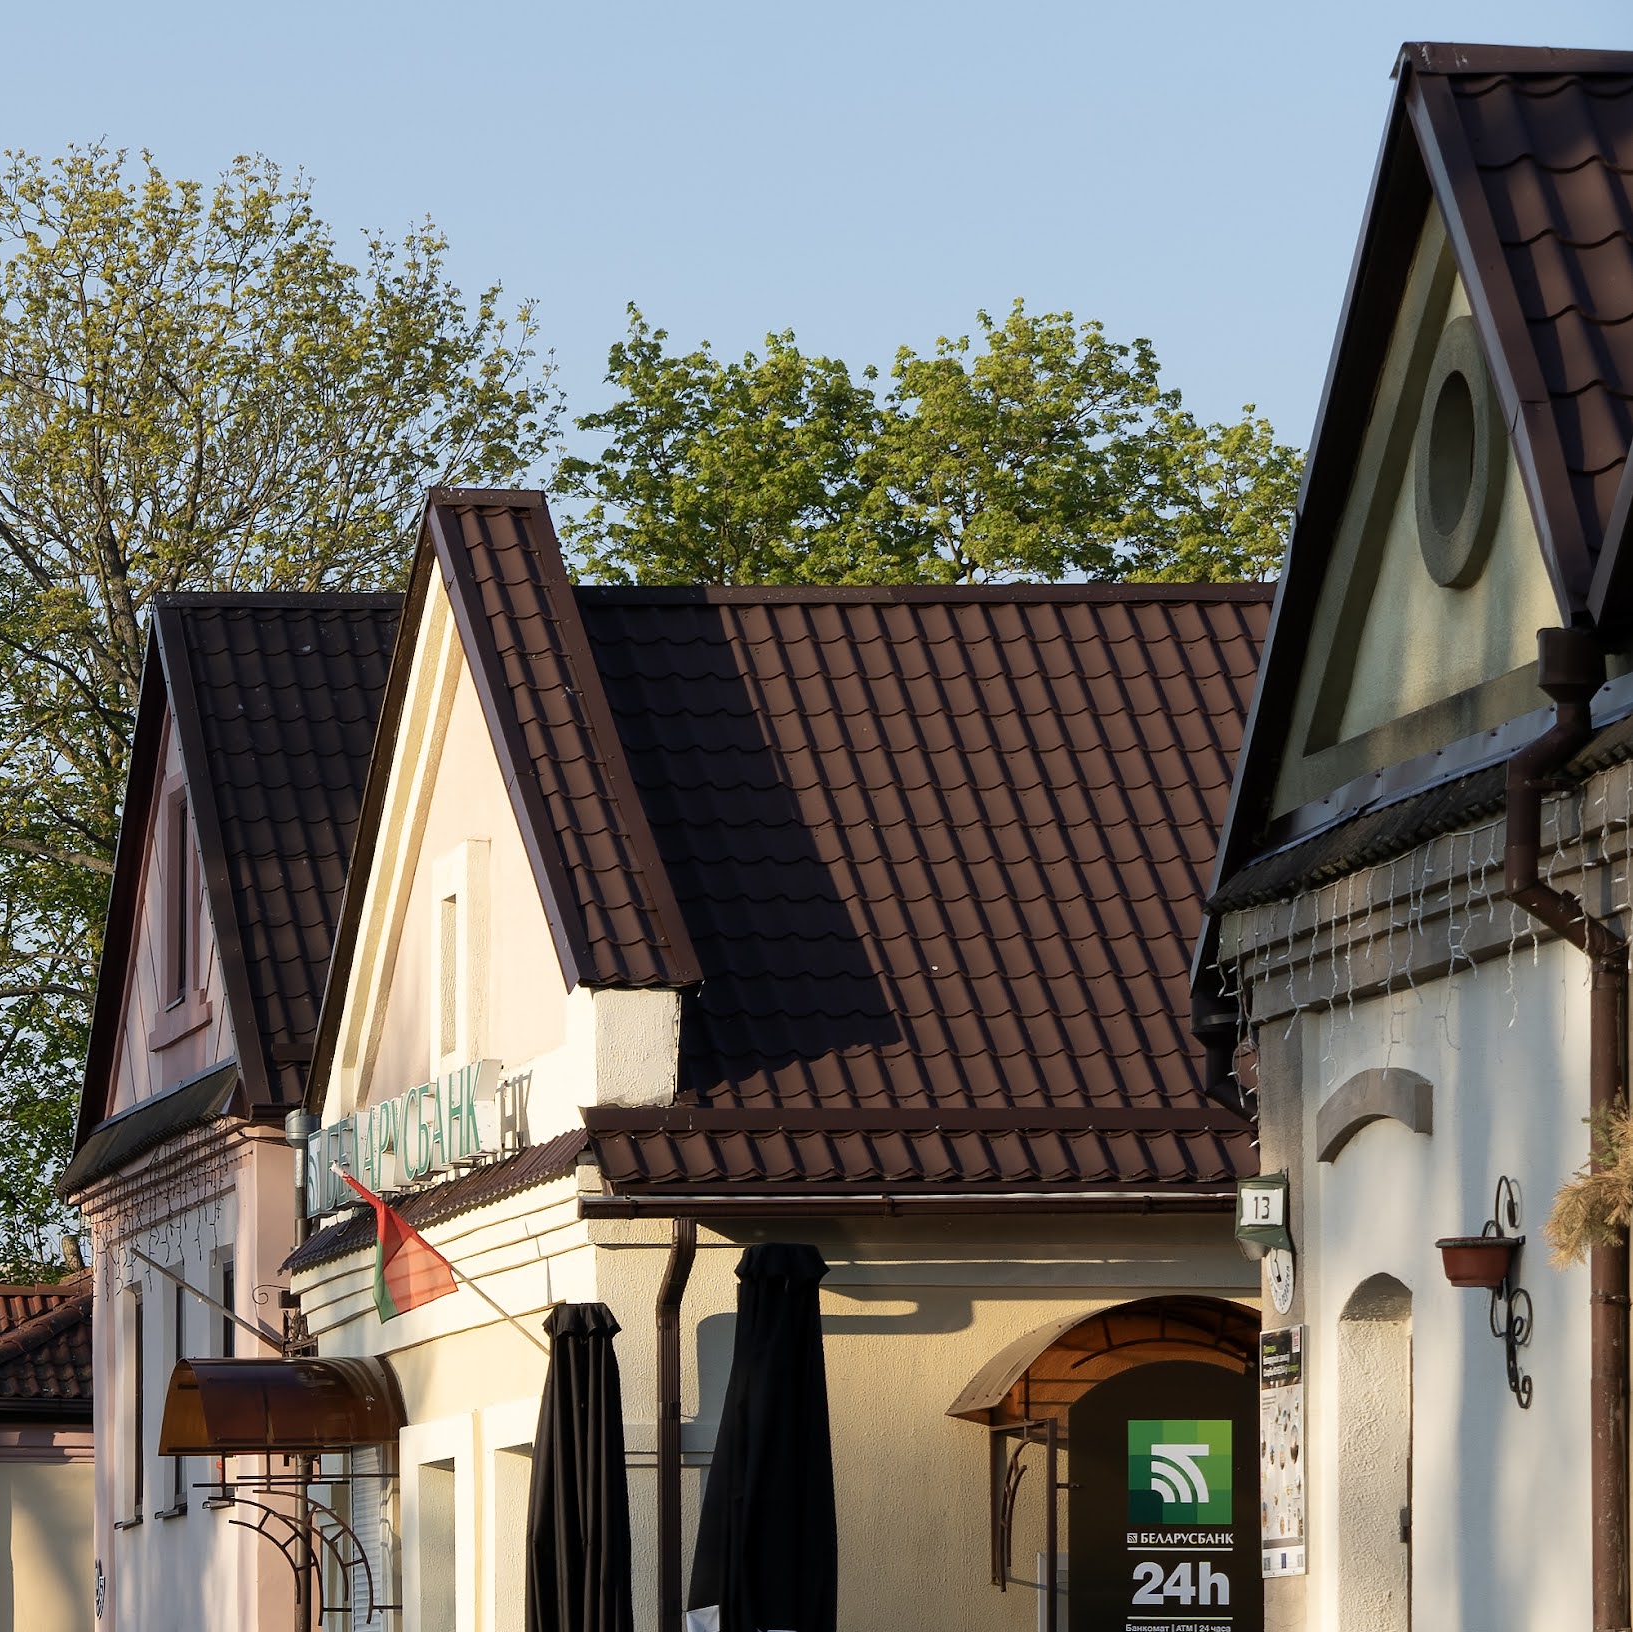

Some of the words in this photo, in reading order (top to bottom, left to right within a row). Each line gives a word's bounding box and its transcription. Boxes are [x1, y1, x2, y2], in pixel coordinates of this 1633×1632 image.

[1254, 1196, 1270, 1219] 13
[1140, 1532, 1234, 1545] БЕЛАРУСБАНК
[1132, 1561, 1230, 1605] 24h
[1125, 1623, 1170, 1632] Банкомат
[1176, 1624, 1193, 1632] ATM
[1199, 1624, 1209, 1632] 24
[1210, 1625, 1231, 1632] часа
